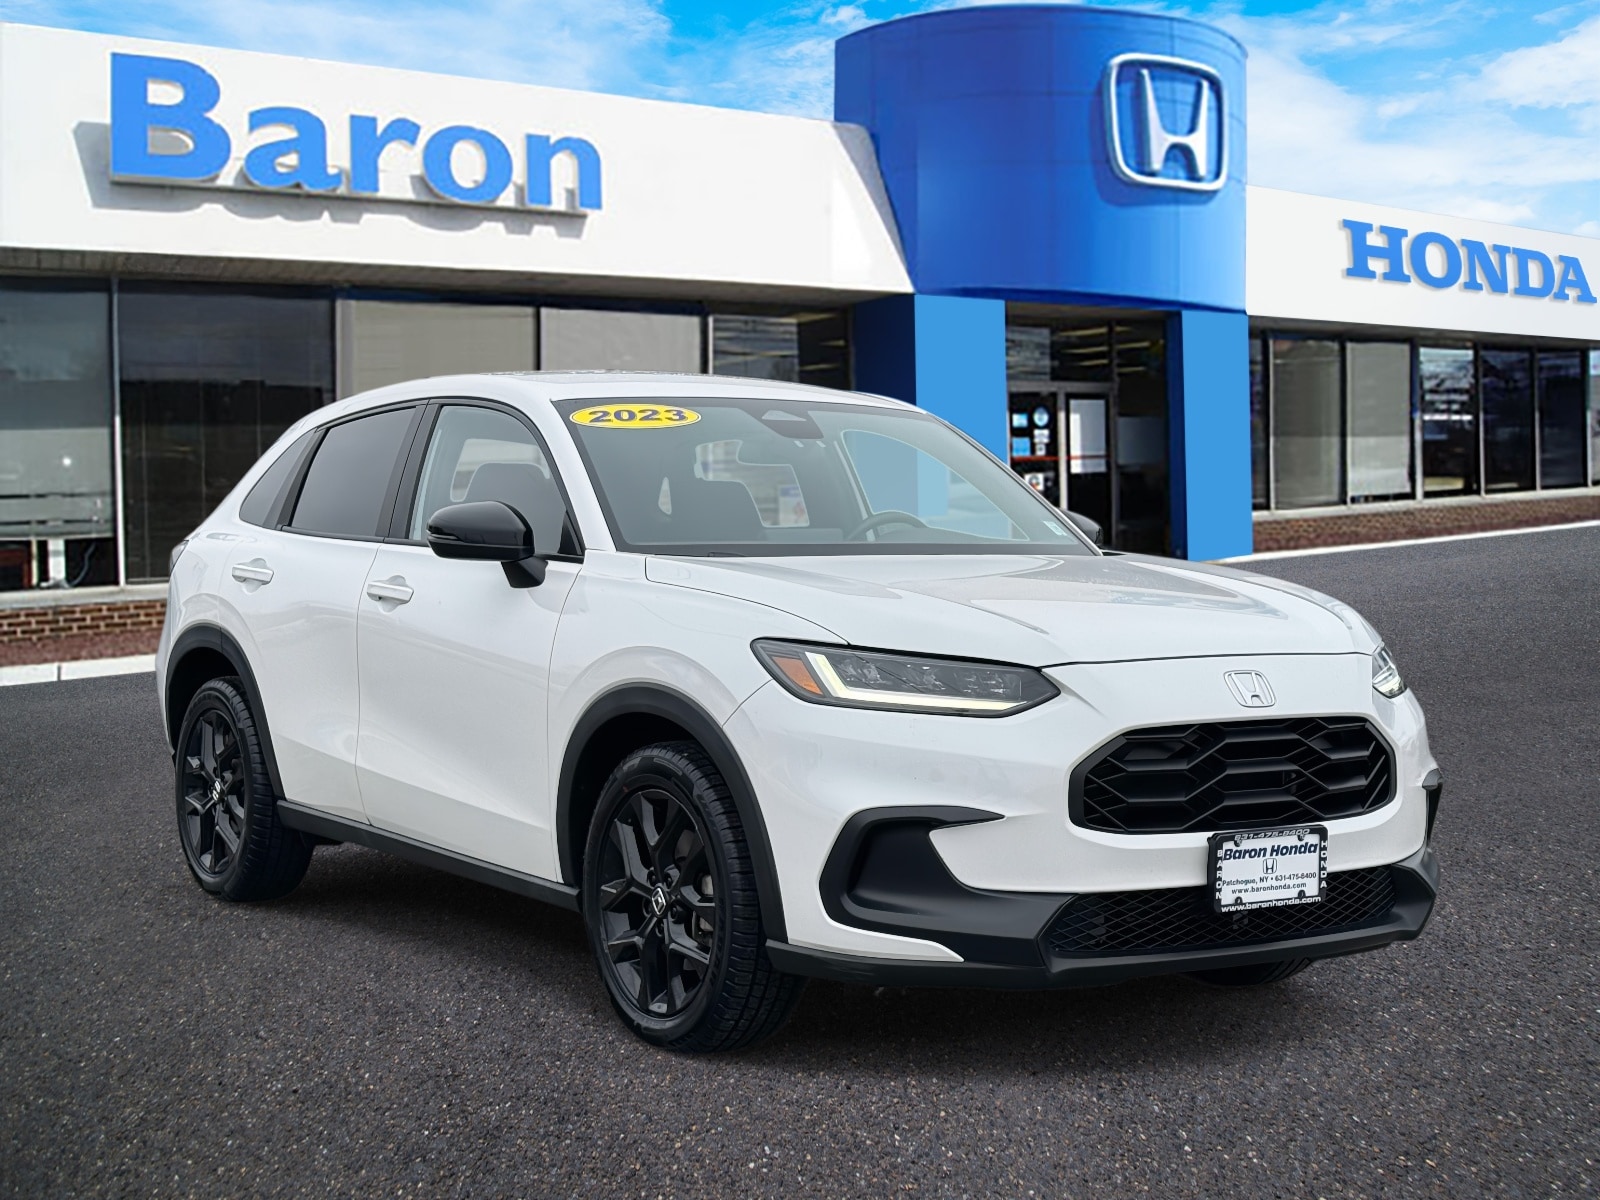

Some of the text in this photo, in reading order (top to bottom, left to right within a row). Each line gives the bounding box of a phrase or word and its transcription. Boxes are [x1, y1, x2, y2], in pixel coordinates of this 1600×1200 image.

[110, 52, 602, 210] Baron
[1342, 219, 1597, 304] HONDA
[589, 409, 688, 423] 2023
[1223, 842, 1319, 861] Baron Honda
[1259, 876, 1269, 884] NY
[1274, 872, 1317, 882] 631-475-8400
[1231, 882, 1307, 895] www.baronhonda.com
[1221, 896, 1322, 913] www.baronhonda.com
